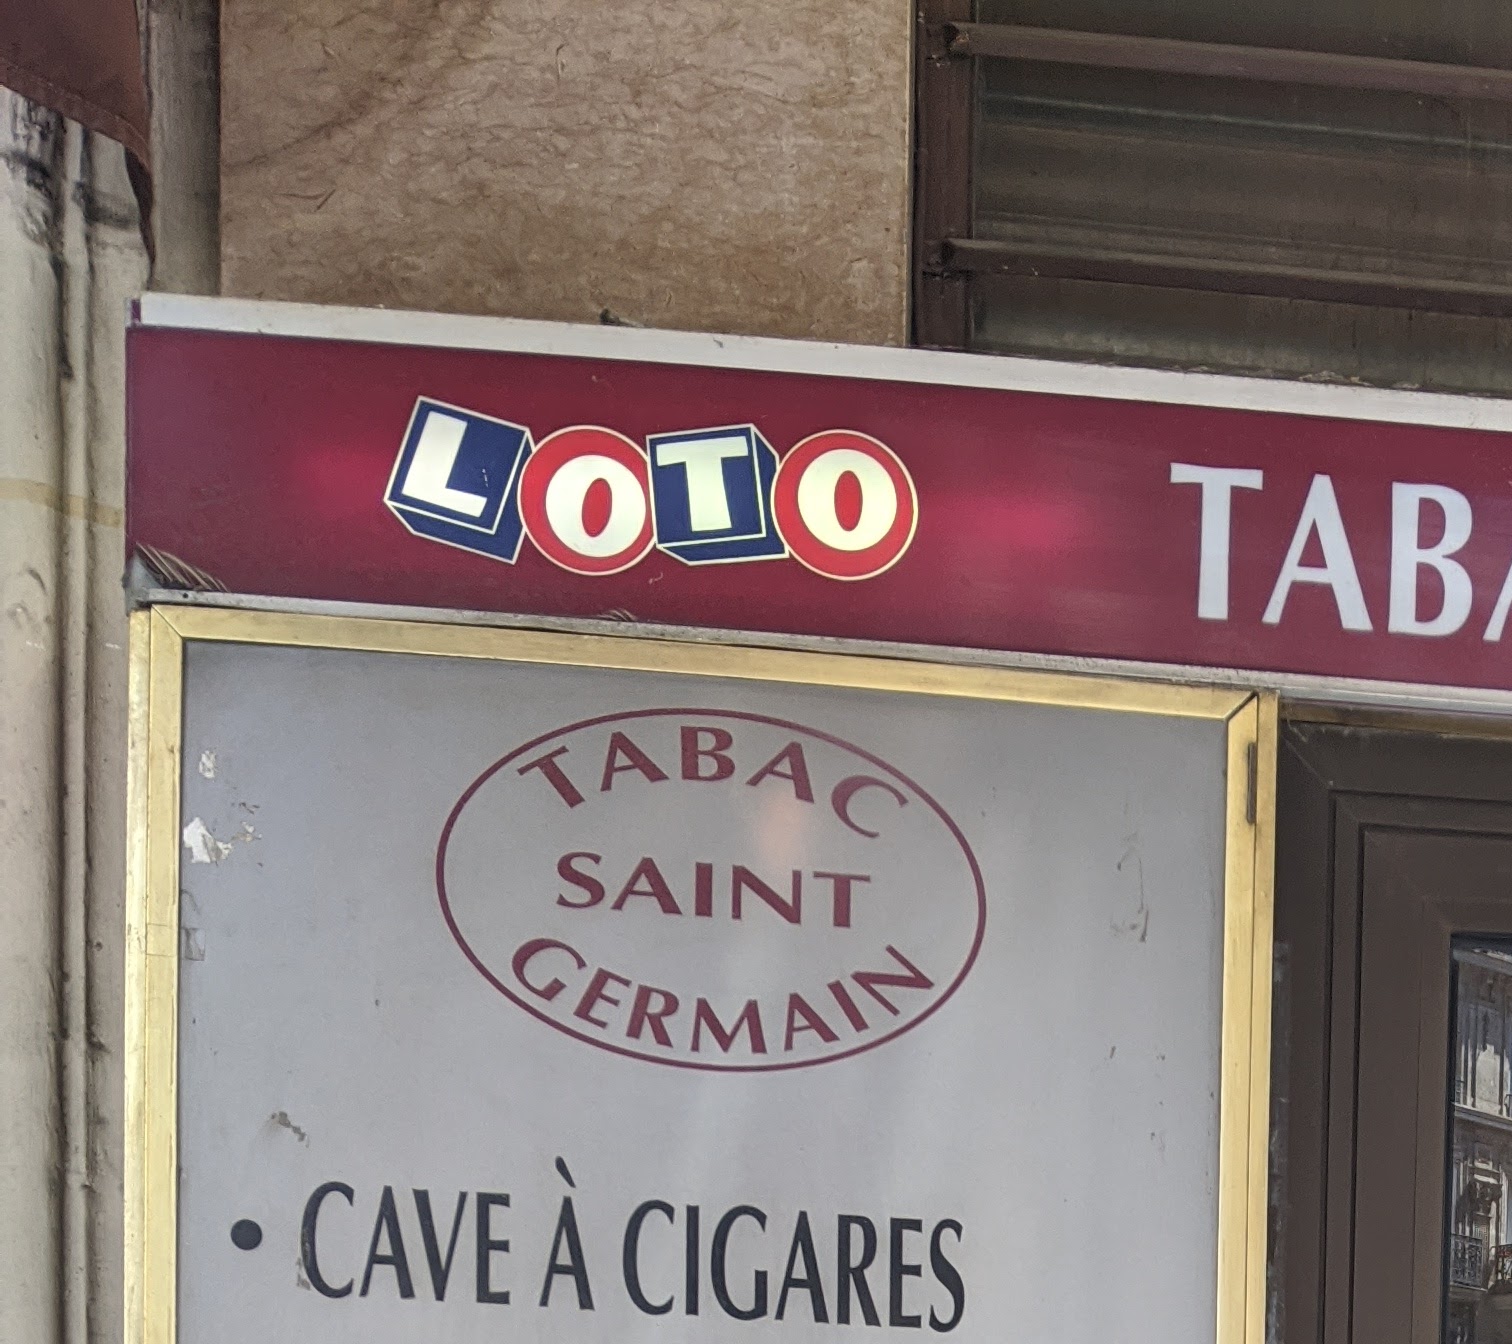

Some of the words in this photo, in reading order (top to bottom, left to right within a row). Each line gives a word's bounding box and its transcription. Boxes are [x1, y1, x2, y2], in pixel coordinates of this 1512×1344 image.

[393, 406, 909, 570] LOTO
[517, 726, 908, 838] TABAC
[556, 850, 872, 930] SAINT
[512, 936, 934, 1055] GERMAIN
[300, 1181, 511, 1306] CAVE
[539, 1156, 595, 1311] À
[622, 1199, 966, 1333] CIGARES
